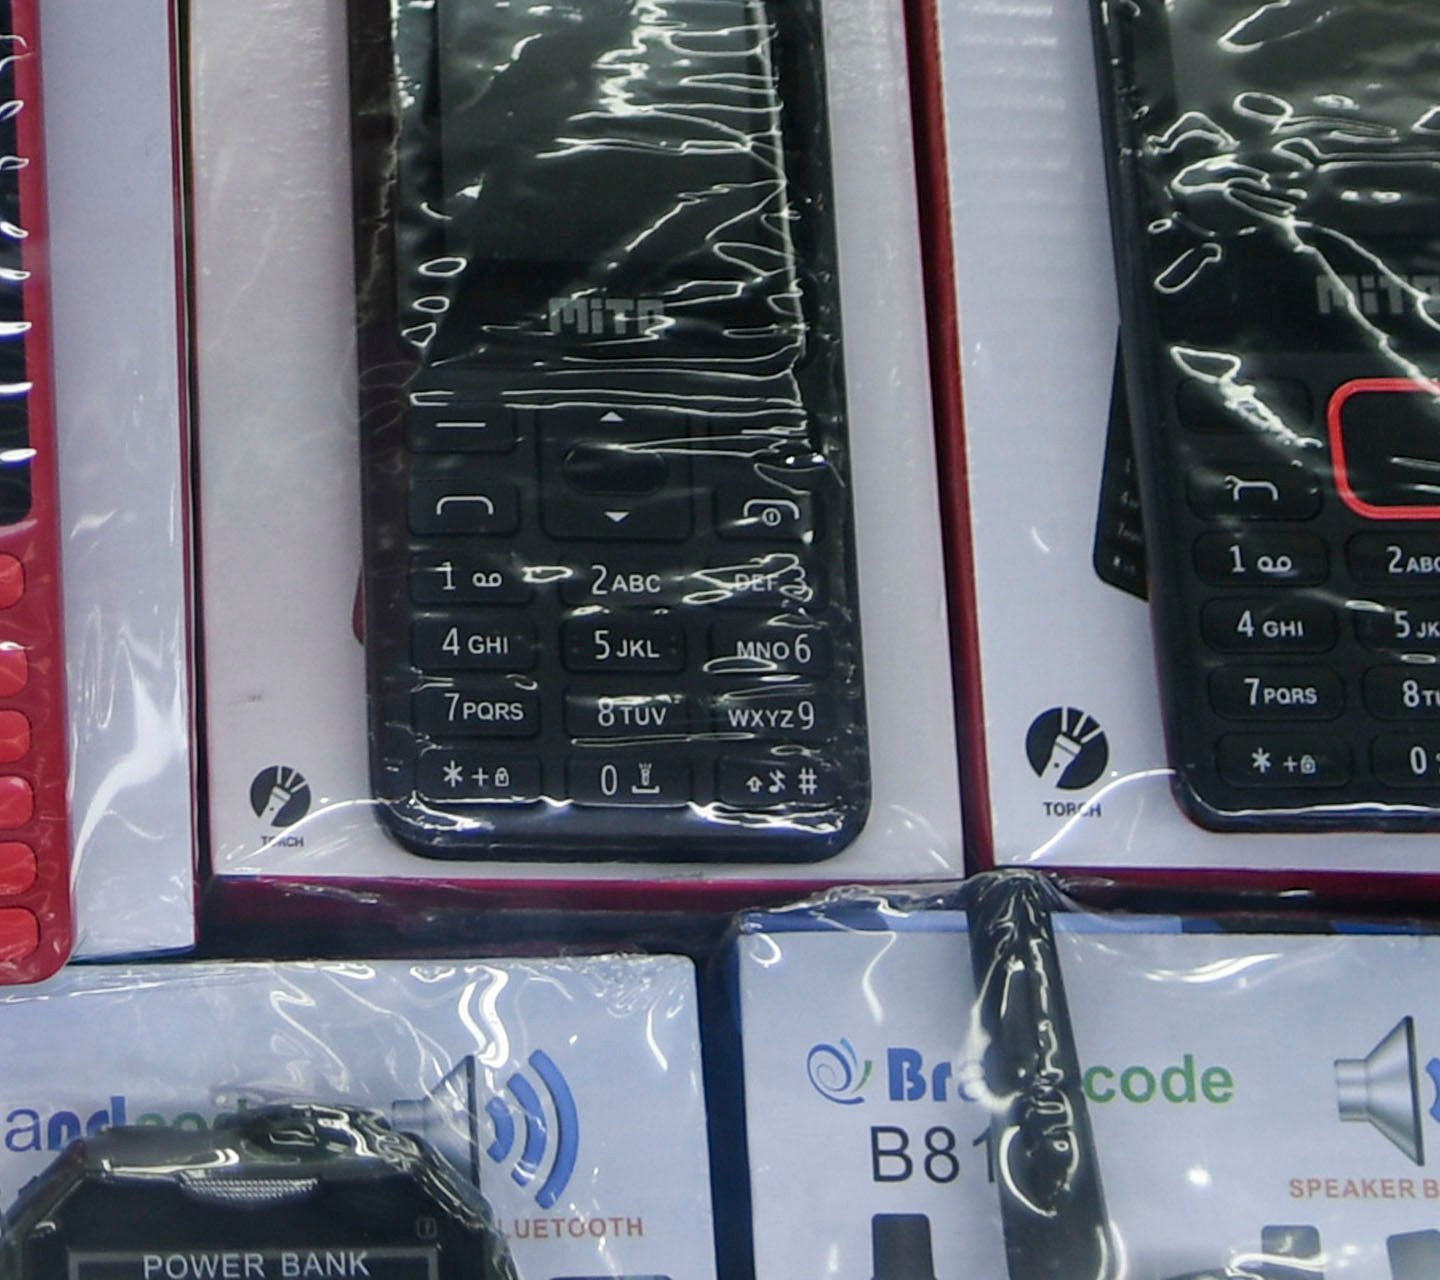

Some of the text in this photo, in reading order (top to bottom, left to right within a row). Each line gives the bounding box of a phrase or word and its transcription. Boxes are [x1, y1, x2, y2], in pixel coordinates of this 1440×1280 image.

[612, 573, 661, 593] ABC
[468, 635, 509, 655] GHI
[616, 638, 659, 659] JKL
[736, 640, 789, 661] MNO
[463, 701, 524, 722] PQRS
[621, 706, 667, 726] TUV
[728, 708, 794, 729] WXYZ
[1287, 1177, 1416, 1201] SPEAKER
[492, 1215, 644, 1239] LUETOOTH
[142, 1251, 370, 1279] POWER BANK
